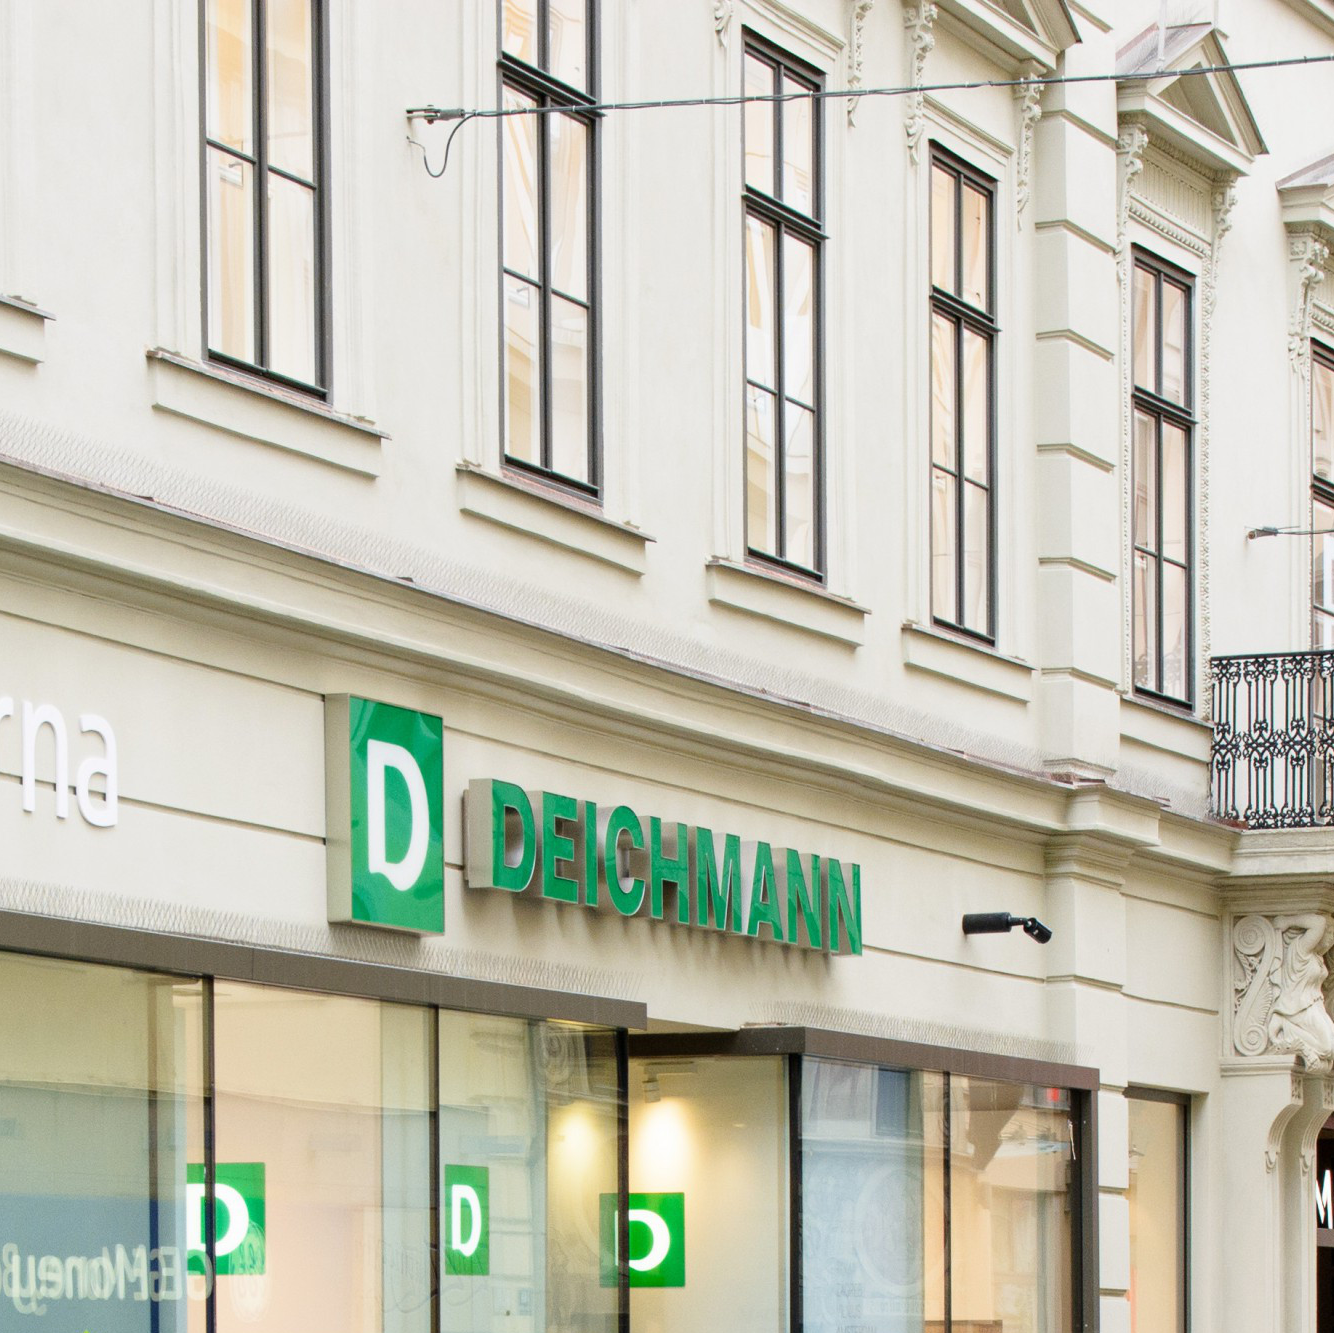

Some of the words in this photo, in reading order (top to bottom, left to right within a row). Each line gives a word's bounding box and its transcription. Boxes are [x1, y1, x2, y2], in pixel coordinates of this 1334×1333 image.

[368, 738, 430, 892] D
[471, 778, 863, 957] DEICHMANN
[185, 1183, 250, 1256] D
[451, 1184, 482, 1257] D
[614, 1209, 671, 1272] D
